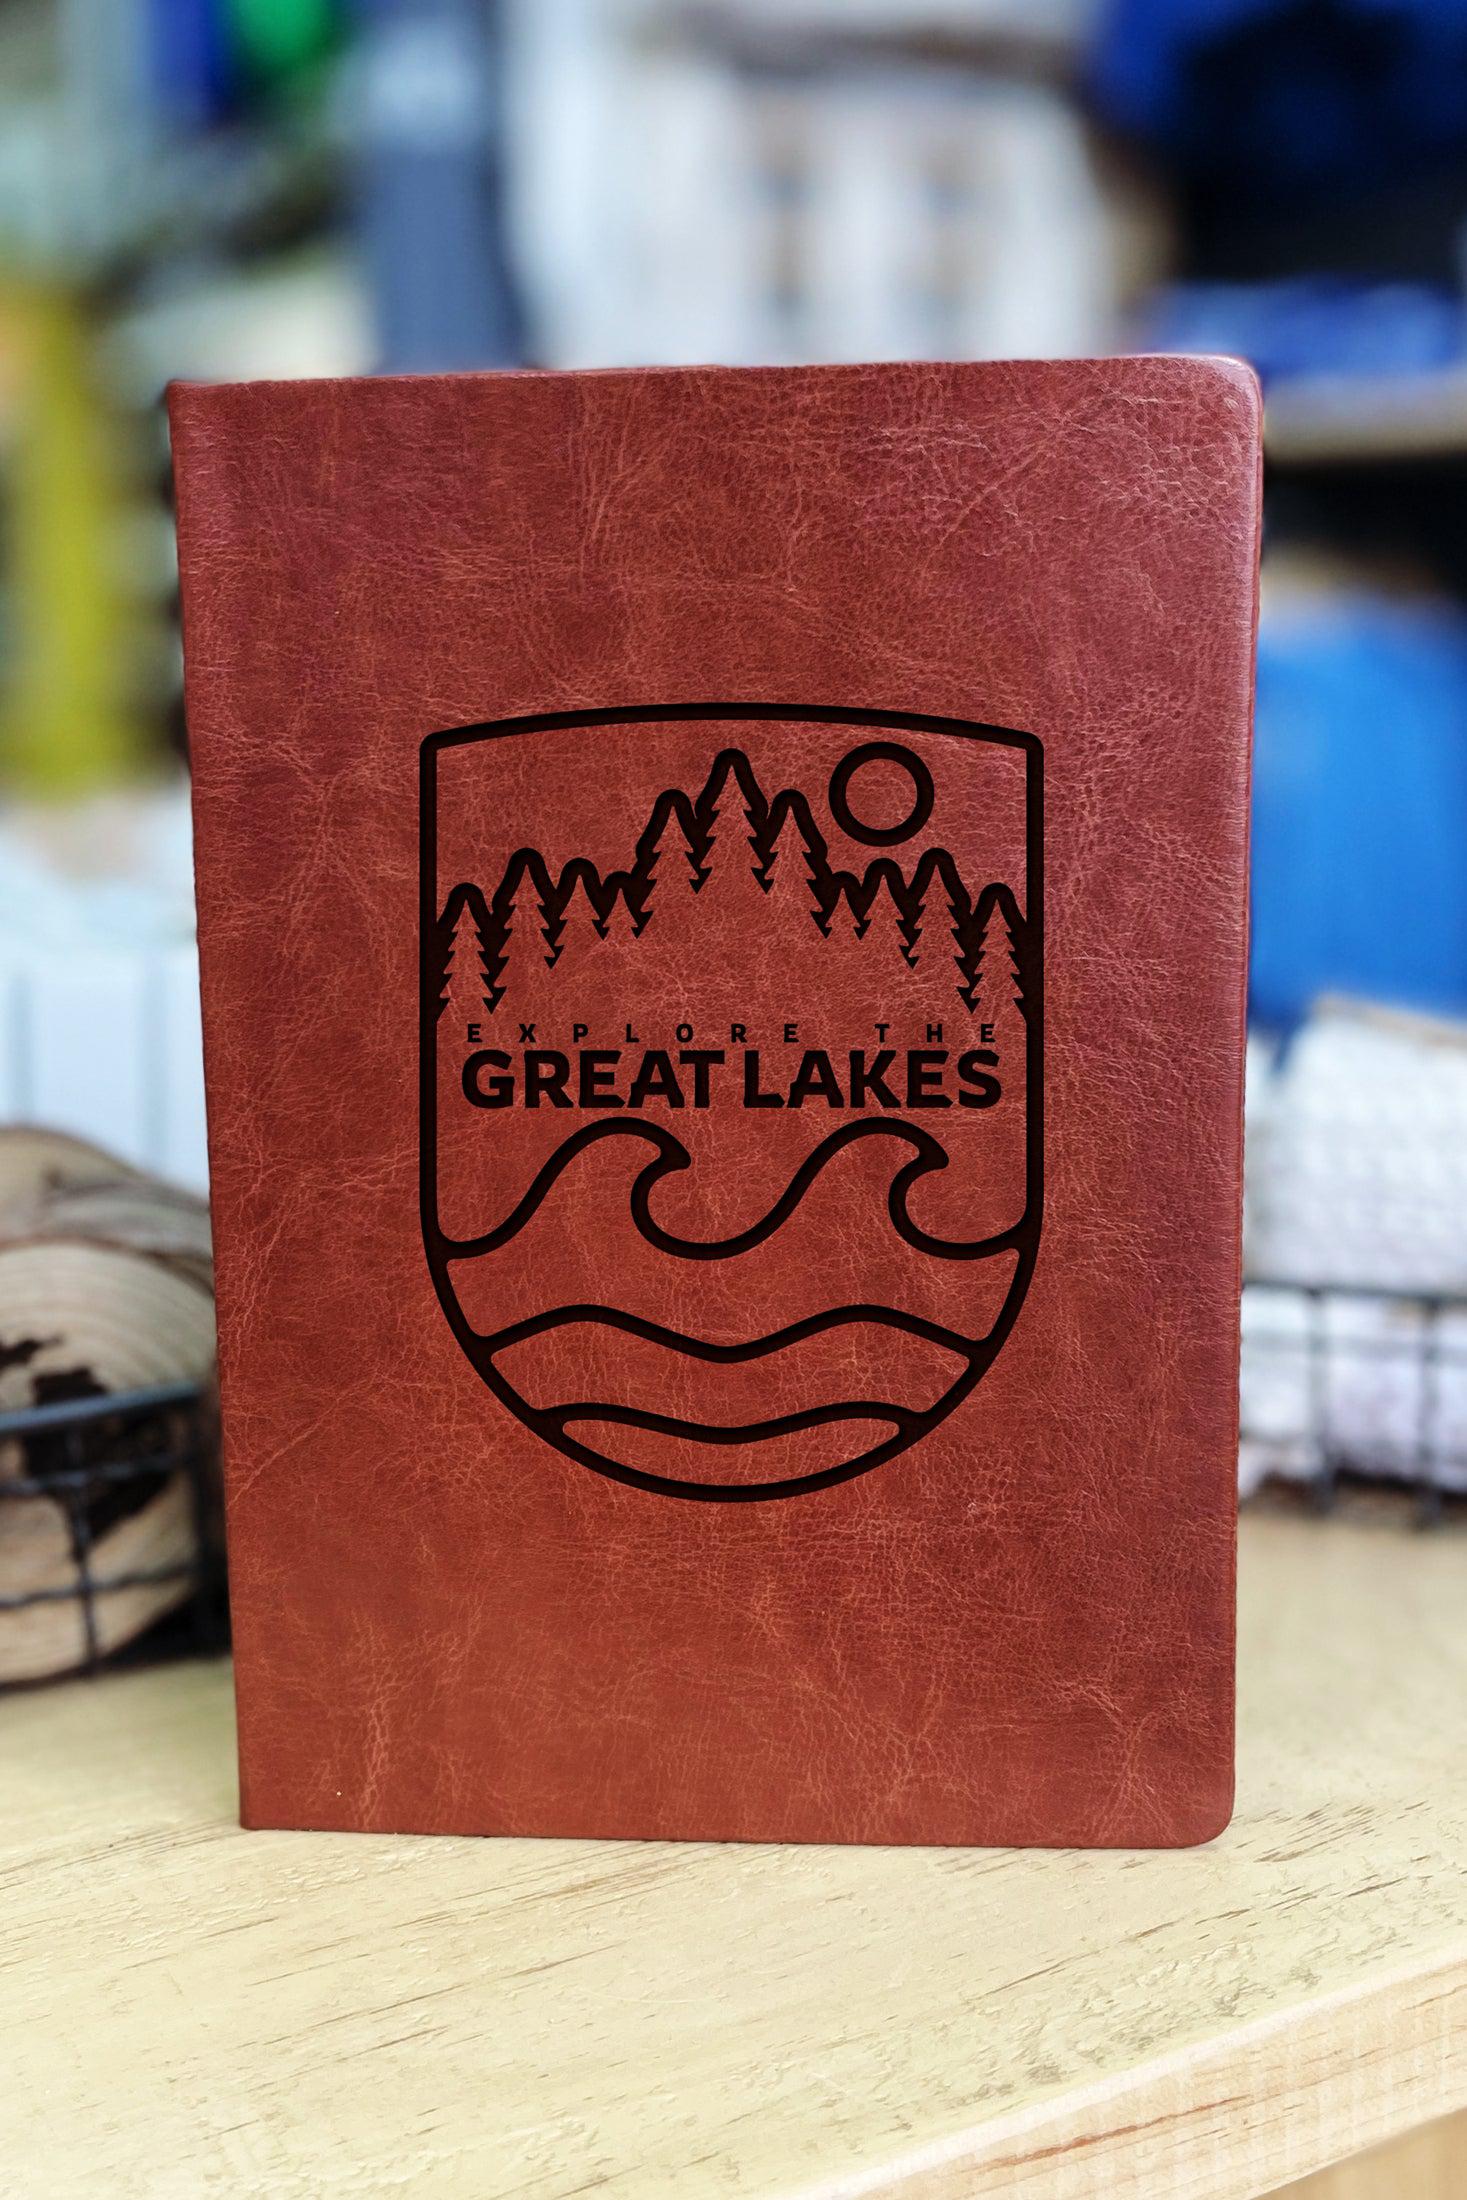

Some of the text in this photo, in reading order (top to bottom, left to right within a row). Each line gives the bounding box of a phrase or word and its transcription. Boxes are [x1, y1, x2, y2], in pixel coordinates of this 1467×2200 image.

[466, 1022, 996, 1044] EXPLORE THE
[461, 1049, 1004, 1110] GREAT LAKES
